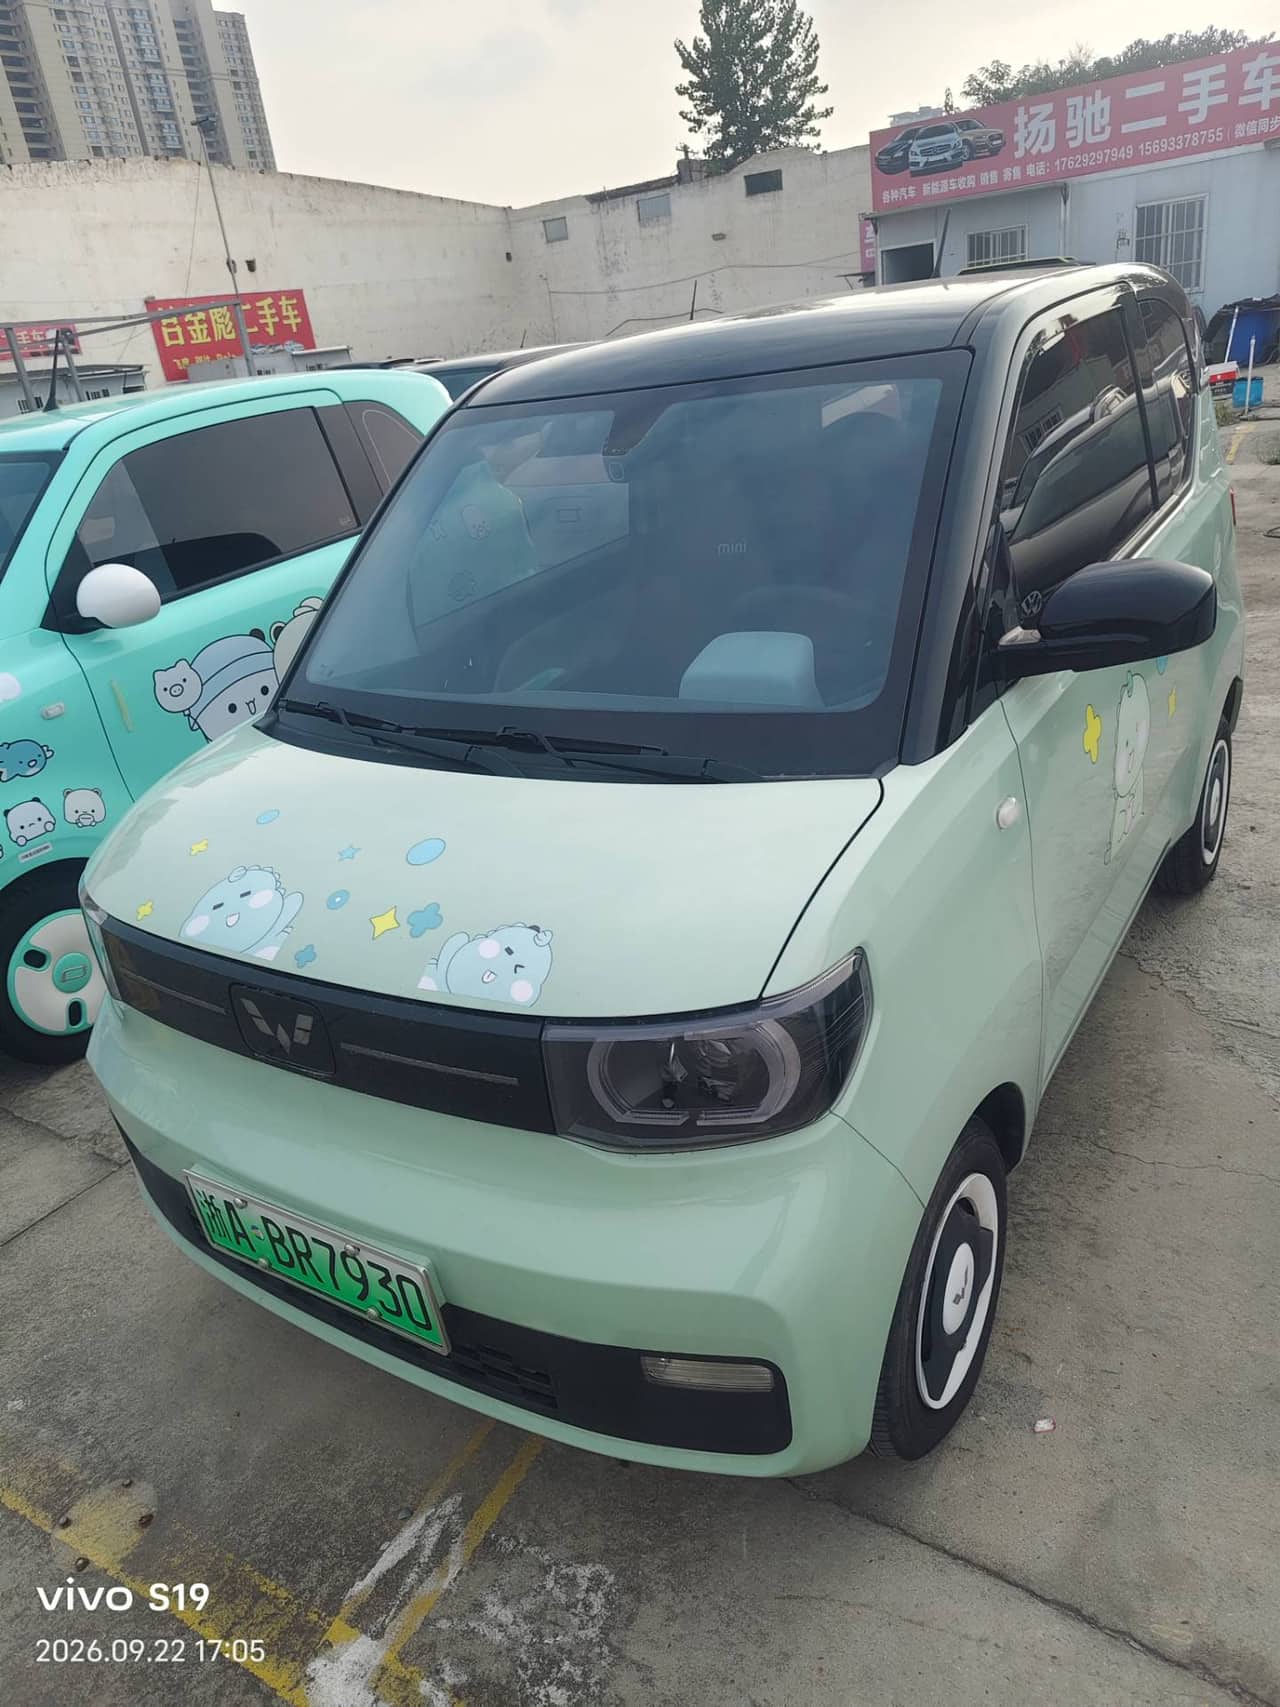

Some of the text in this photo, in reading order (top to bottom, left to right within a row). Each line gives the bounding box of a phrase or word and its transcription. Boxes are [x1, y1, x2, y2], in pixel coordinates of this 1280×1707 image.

[1013, 52, 1280, 159] 扬驰二手车
[1055, 144, 1133, 172] 17629297949
[1138, 127, 1223, 156] 15693378755
